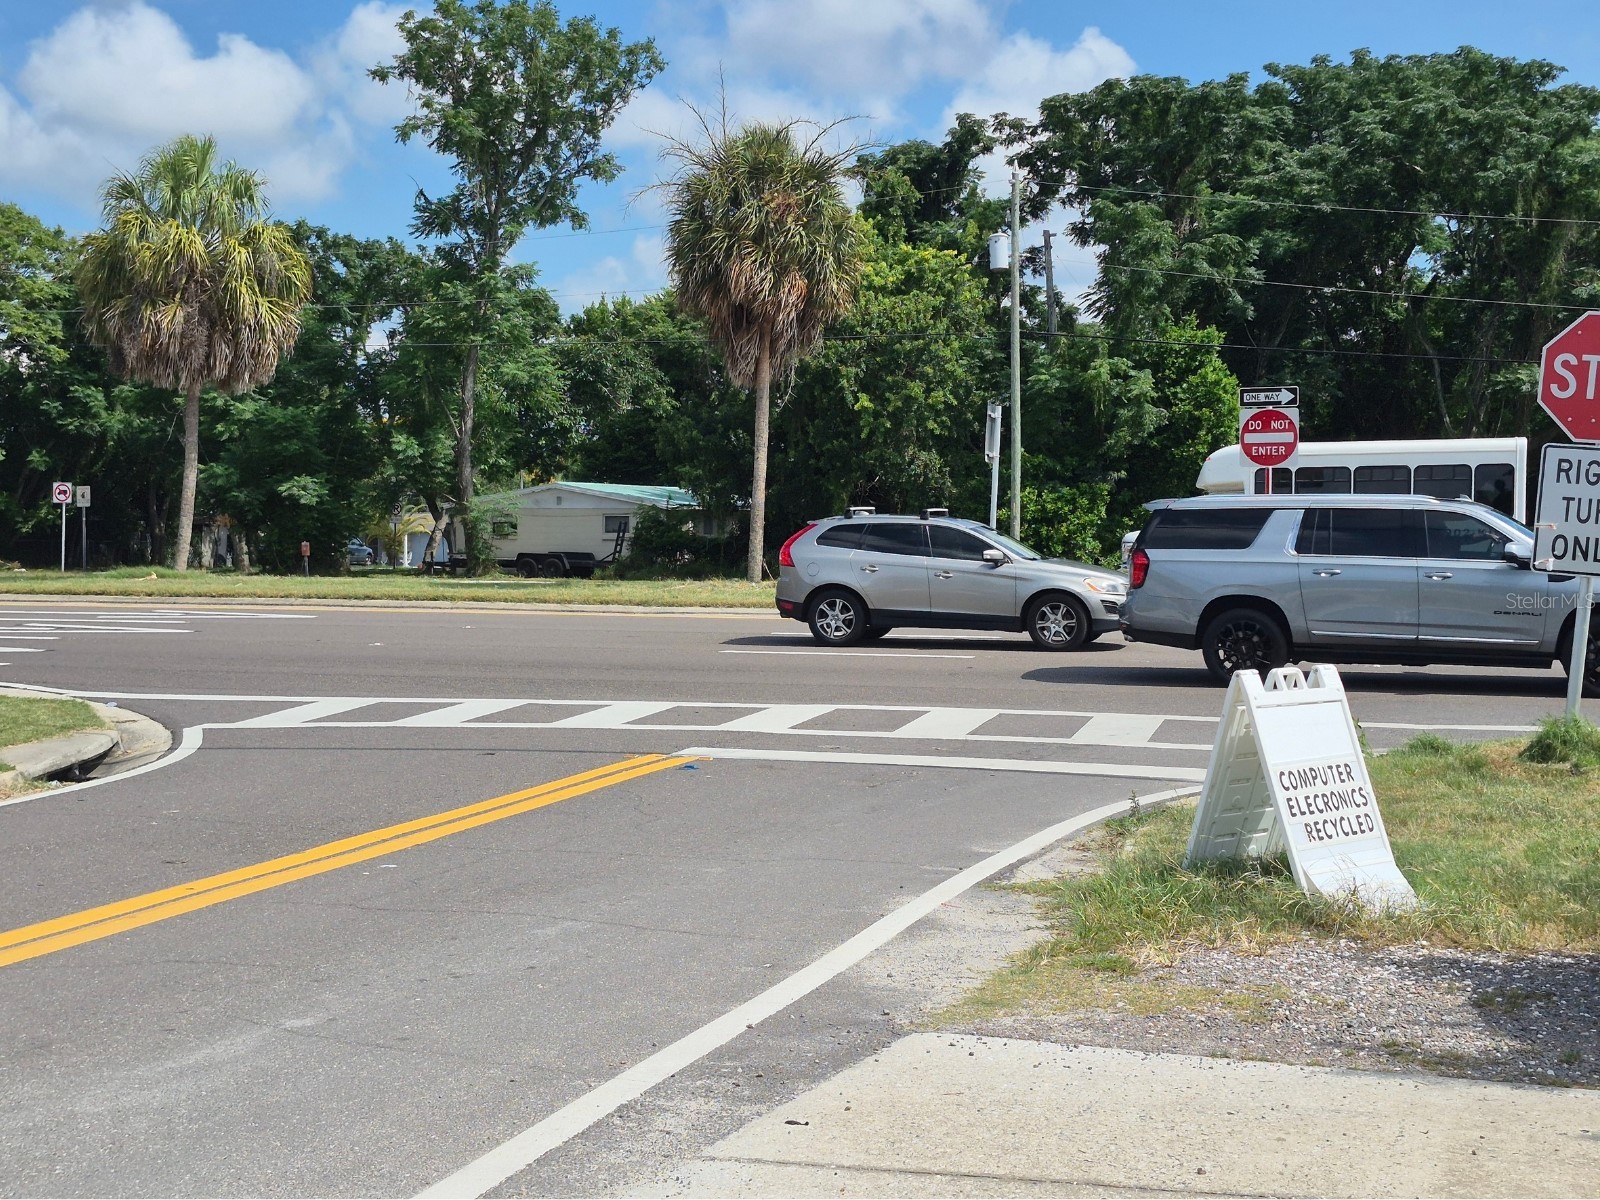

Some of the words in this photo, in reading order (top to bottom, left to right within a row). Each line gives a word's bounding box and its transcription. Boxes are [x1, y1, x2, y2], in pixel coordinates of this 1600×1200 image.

[1550, 353, 1600, 400] ST
[1245, 394, 1261, 402] ONE
[1263, 393, 1281, 401] WAY
[1248, 420, 1262, 430] DO
[1270, 419, 1291, 430] NOT
[1252, 446, 1286, 456] ENTER
[1556, 458, 1600, 486] RIG
[1279, 763, 1354, 792] COMPUTER
[1286, 786, 1368, 817] ELECRONICS
[1304, 813, 1374, 842] RECYCLED
